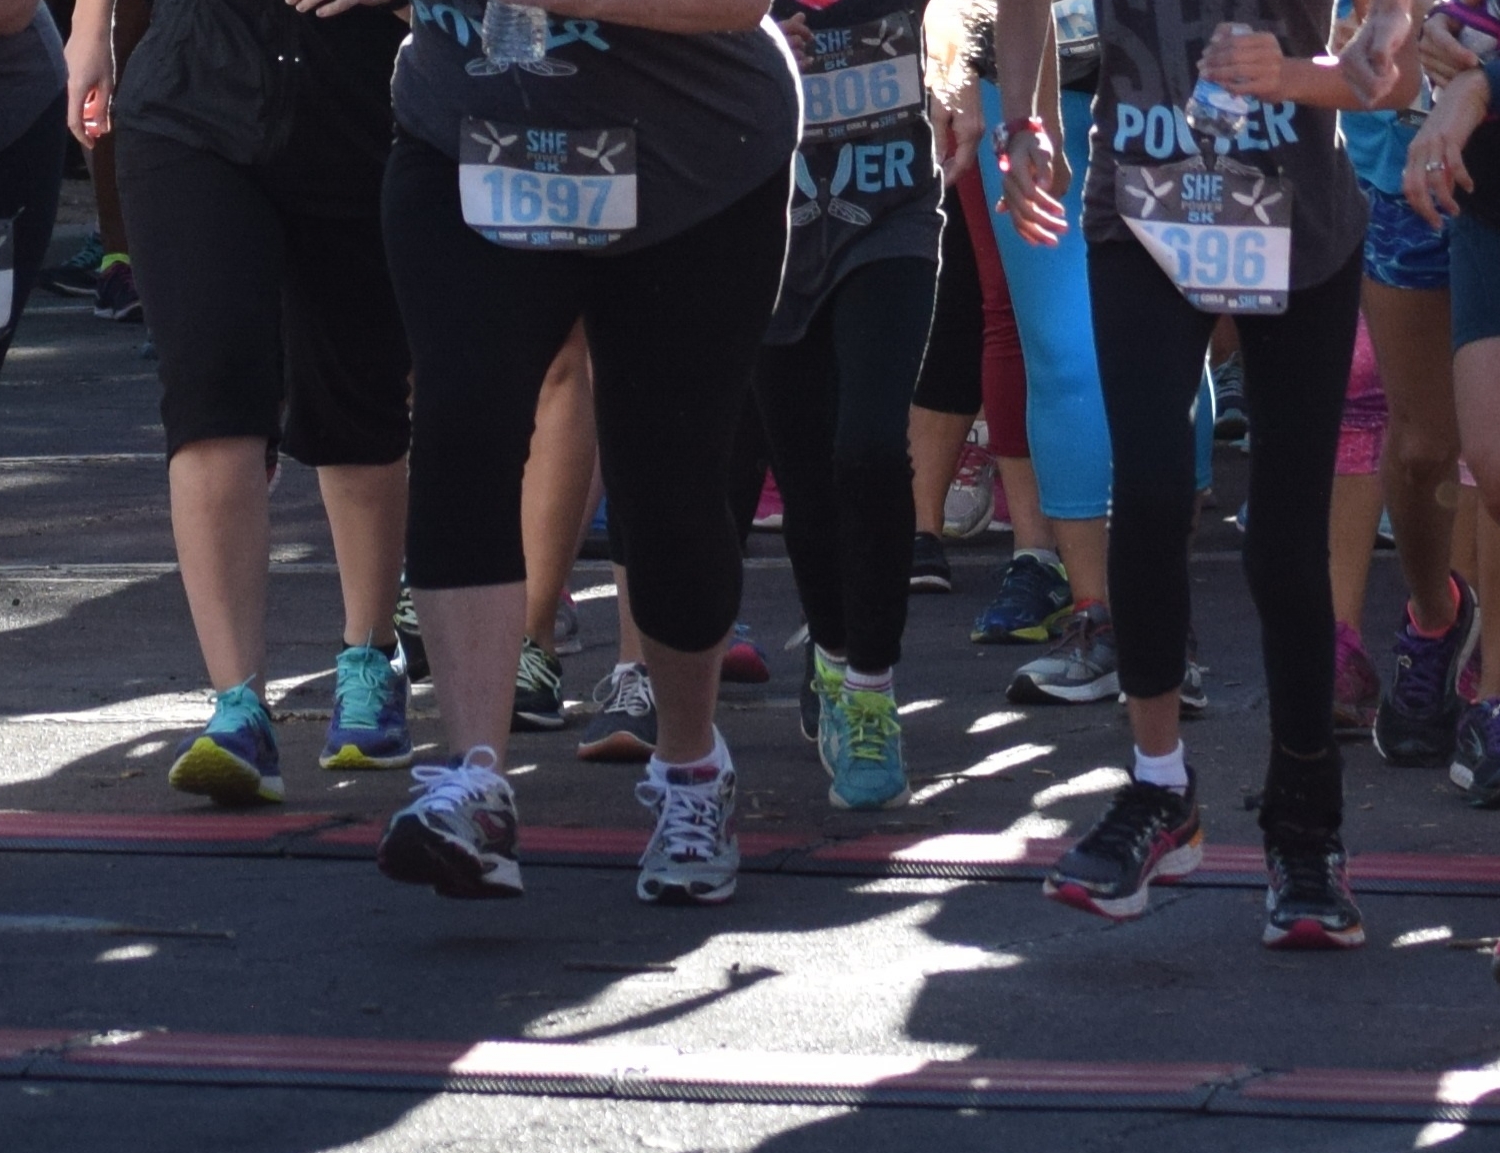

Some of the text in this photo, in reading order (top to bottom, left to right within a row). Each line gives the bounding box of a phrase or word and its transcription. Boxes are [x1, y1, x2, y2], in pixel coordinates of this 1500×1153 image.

[816, 30, 852, 54] SHE
[825, 59, 848, 71] 5K
[526, 129, 568, 154] SHE
[534, 163, 560, 173] 5K
[1182, 173, 1223, 201] SHE
[482, 168, 613, 228] 1697
[1188, 211, 1214, 224] 5K
[530, 231, 550, 245] SHE
